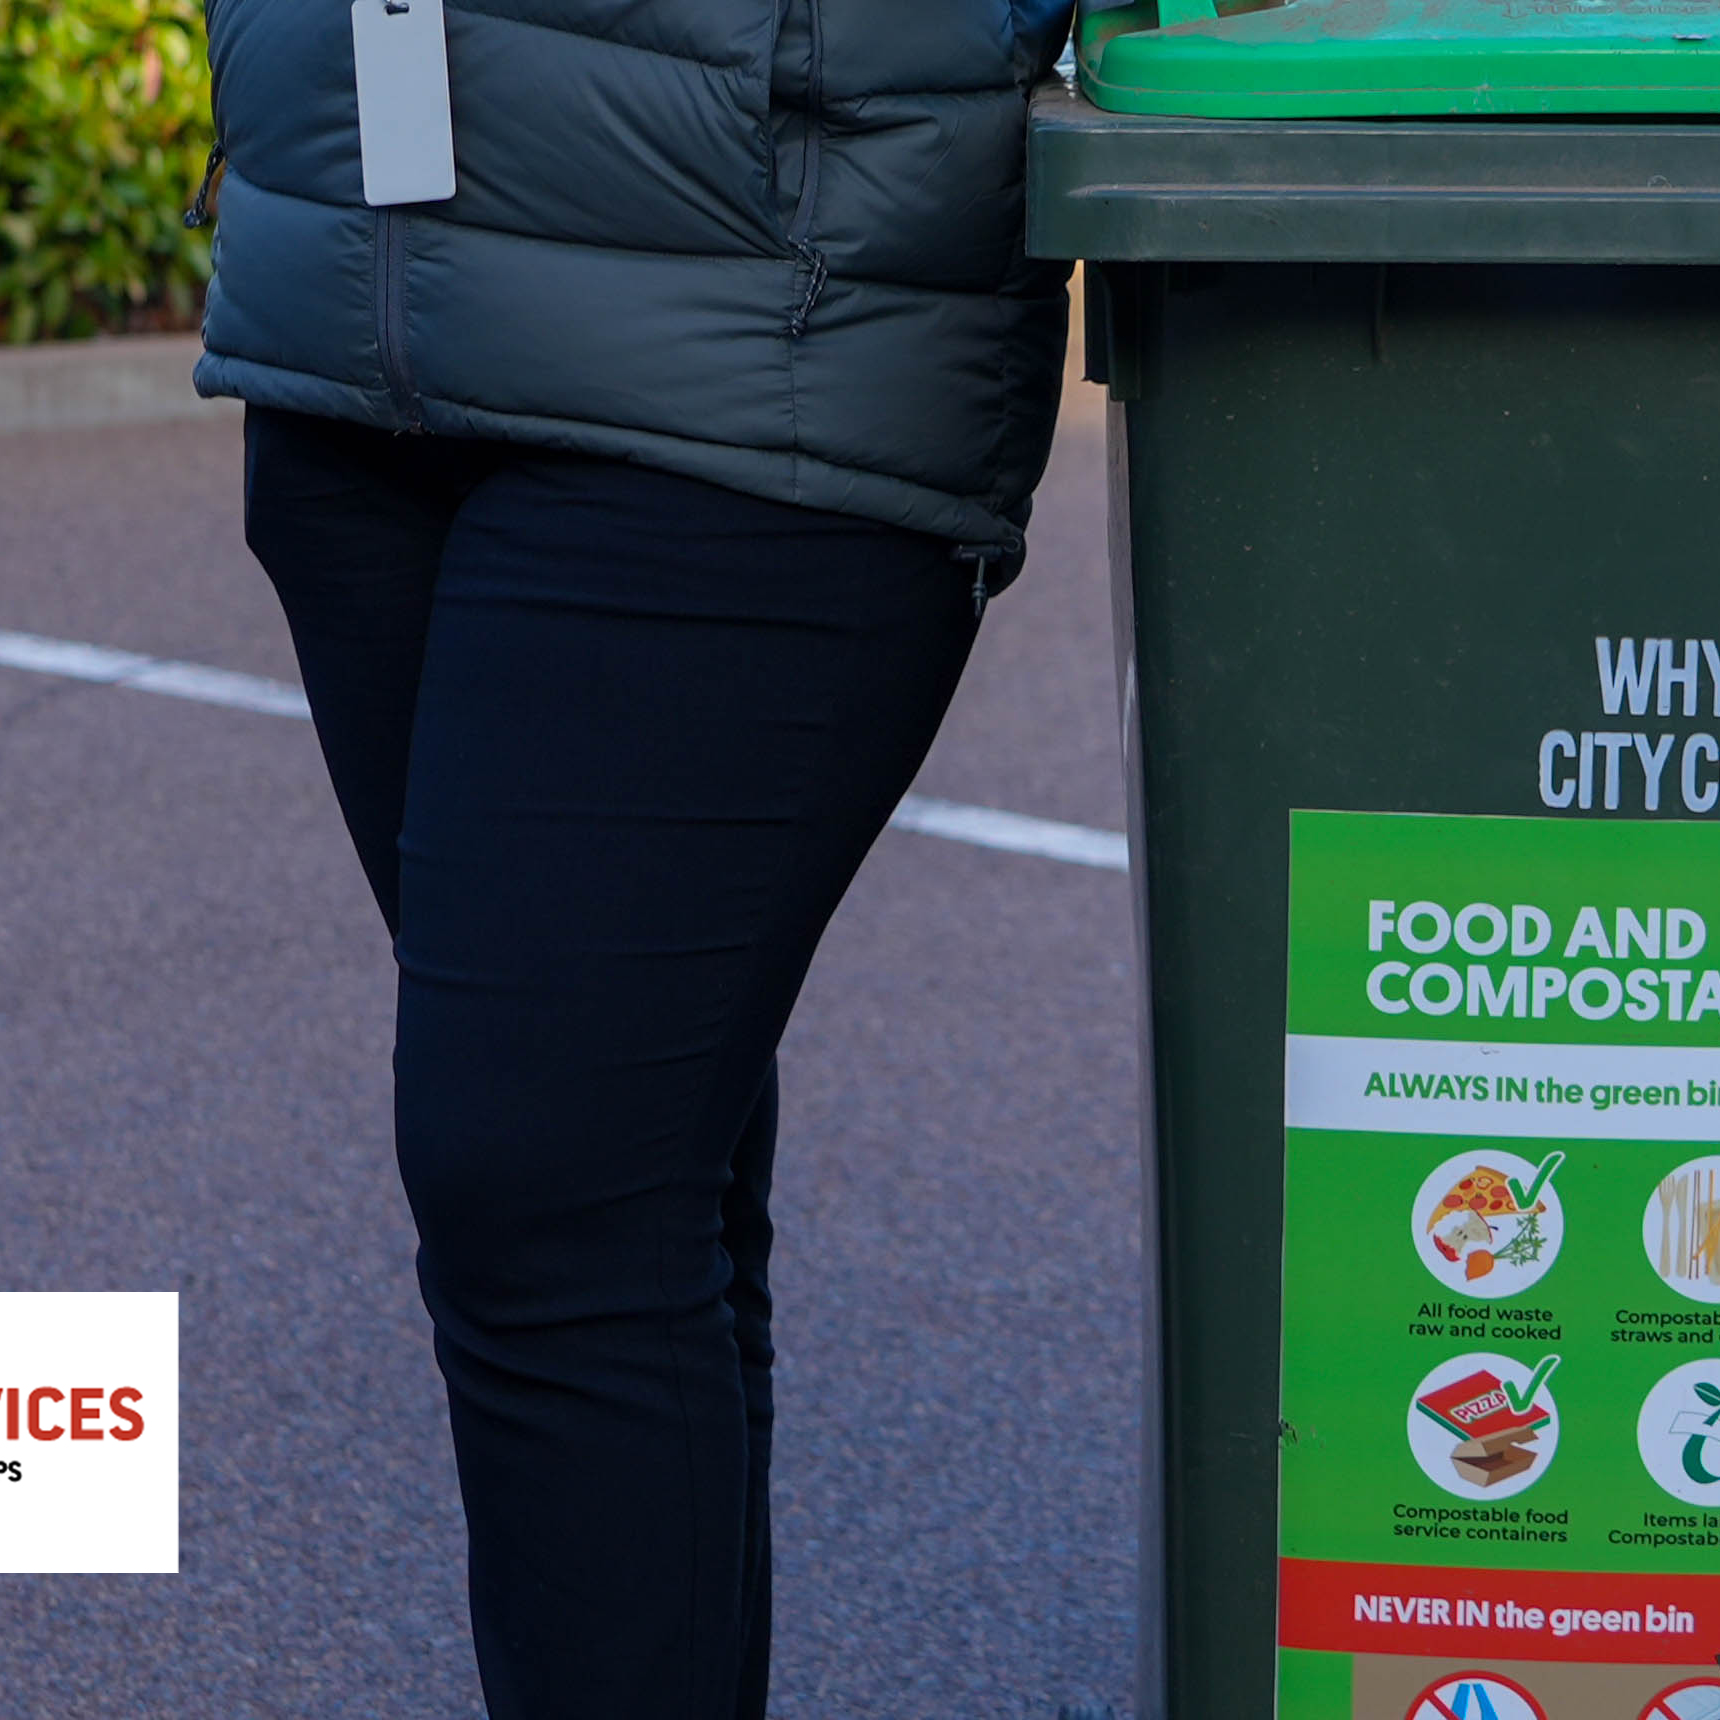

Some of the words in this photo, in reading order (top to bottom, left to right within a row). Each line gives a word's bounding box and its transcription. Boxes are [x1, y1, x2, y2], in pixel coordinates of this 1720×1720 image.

[1539, 729, 1675, 811] CITY
[1368, 899, 1552, 958] FOOD
[1564, 906, 1706, 960] AND
[1364, 1071, 1489, 1101] ALWAYS
[1496, 1077, 1529, 1101] IN
[1534, 1076, 1583, 1104] the
[1589, 1082, 1680, 1110] green
[1418, 1303, 1442, 1319] All
[1448, 1304, 1490, 1320] food
[1496, 1308, 1553, 1322] waste
[1409, 1323, 1444, 1337] raw
[1448, 1323, 1486, 1338] and
[1491, 1324, 1561, 1340] cooked
[1610, 1330, 1672, 1344] straws
[1678, 1329, 1713, 1345] and
[1393, 1503, 1519, 1523] Compostable
[1526, 1510, 1568, 1525] food
[1644, 1514, 1697, 1529] Items
[1393, 1523, 1461, 1539] service
[1466, 1525, 1568, 1543] containers
[1354, 1594, 1450, 1626] NEVER
[1457, 1600, 1489, 1626] IN
[1495, 1602, 1544, 1629] the
[1550, 1607, 1639, 1637] green
[1645, 1604, 1694, 1633] bin
